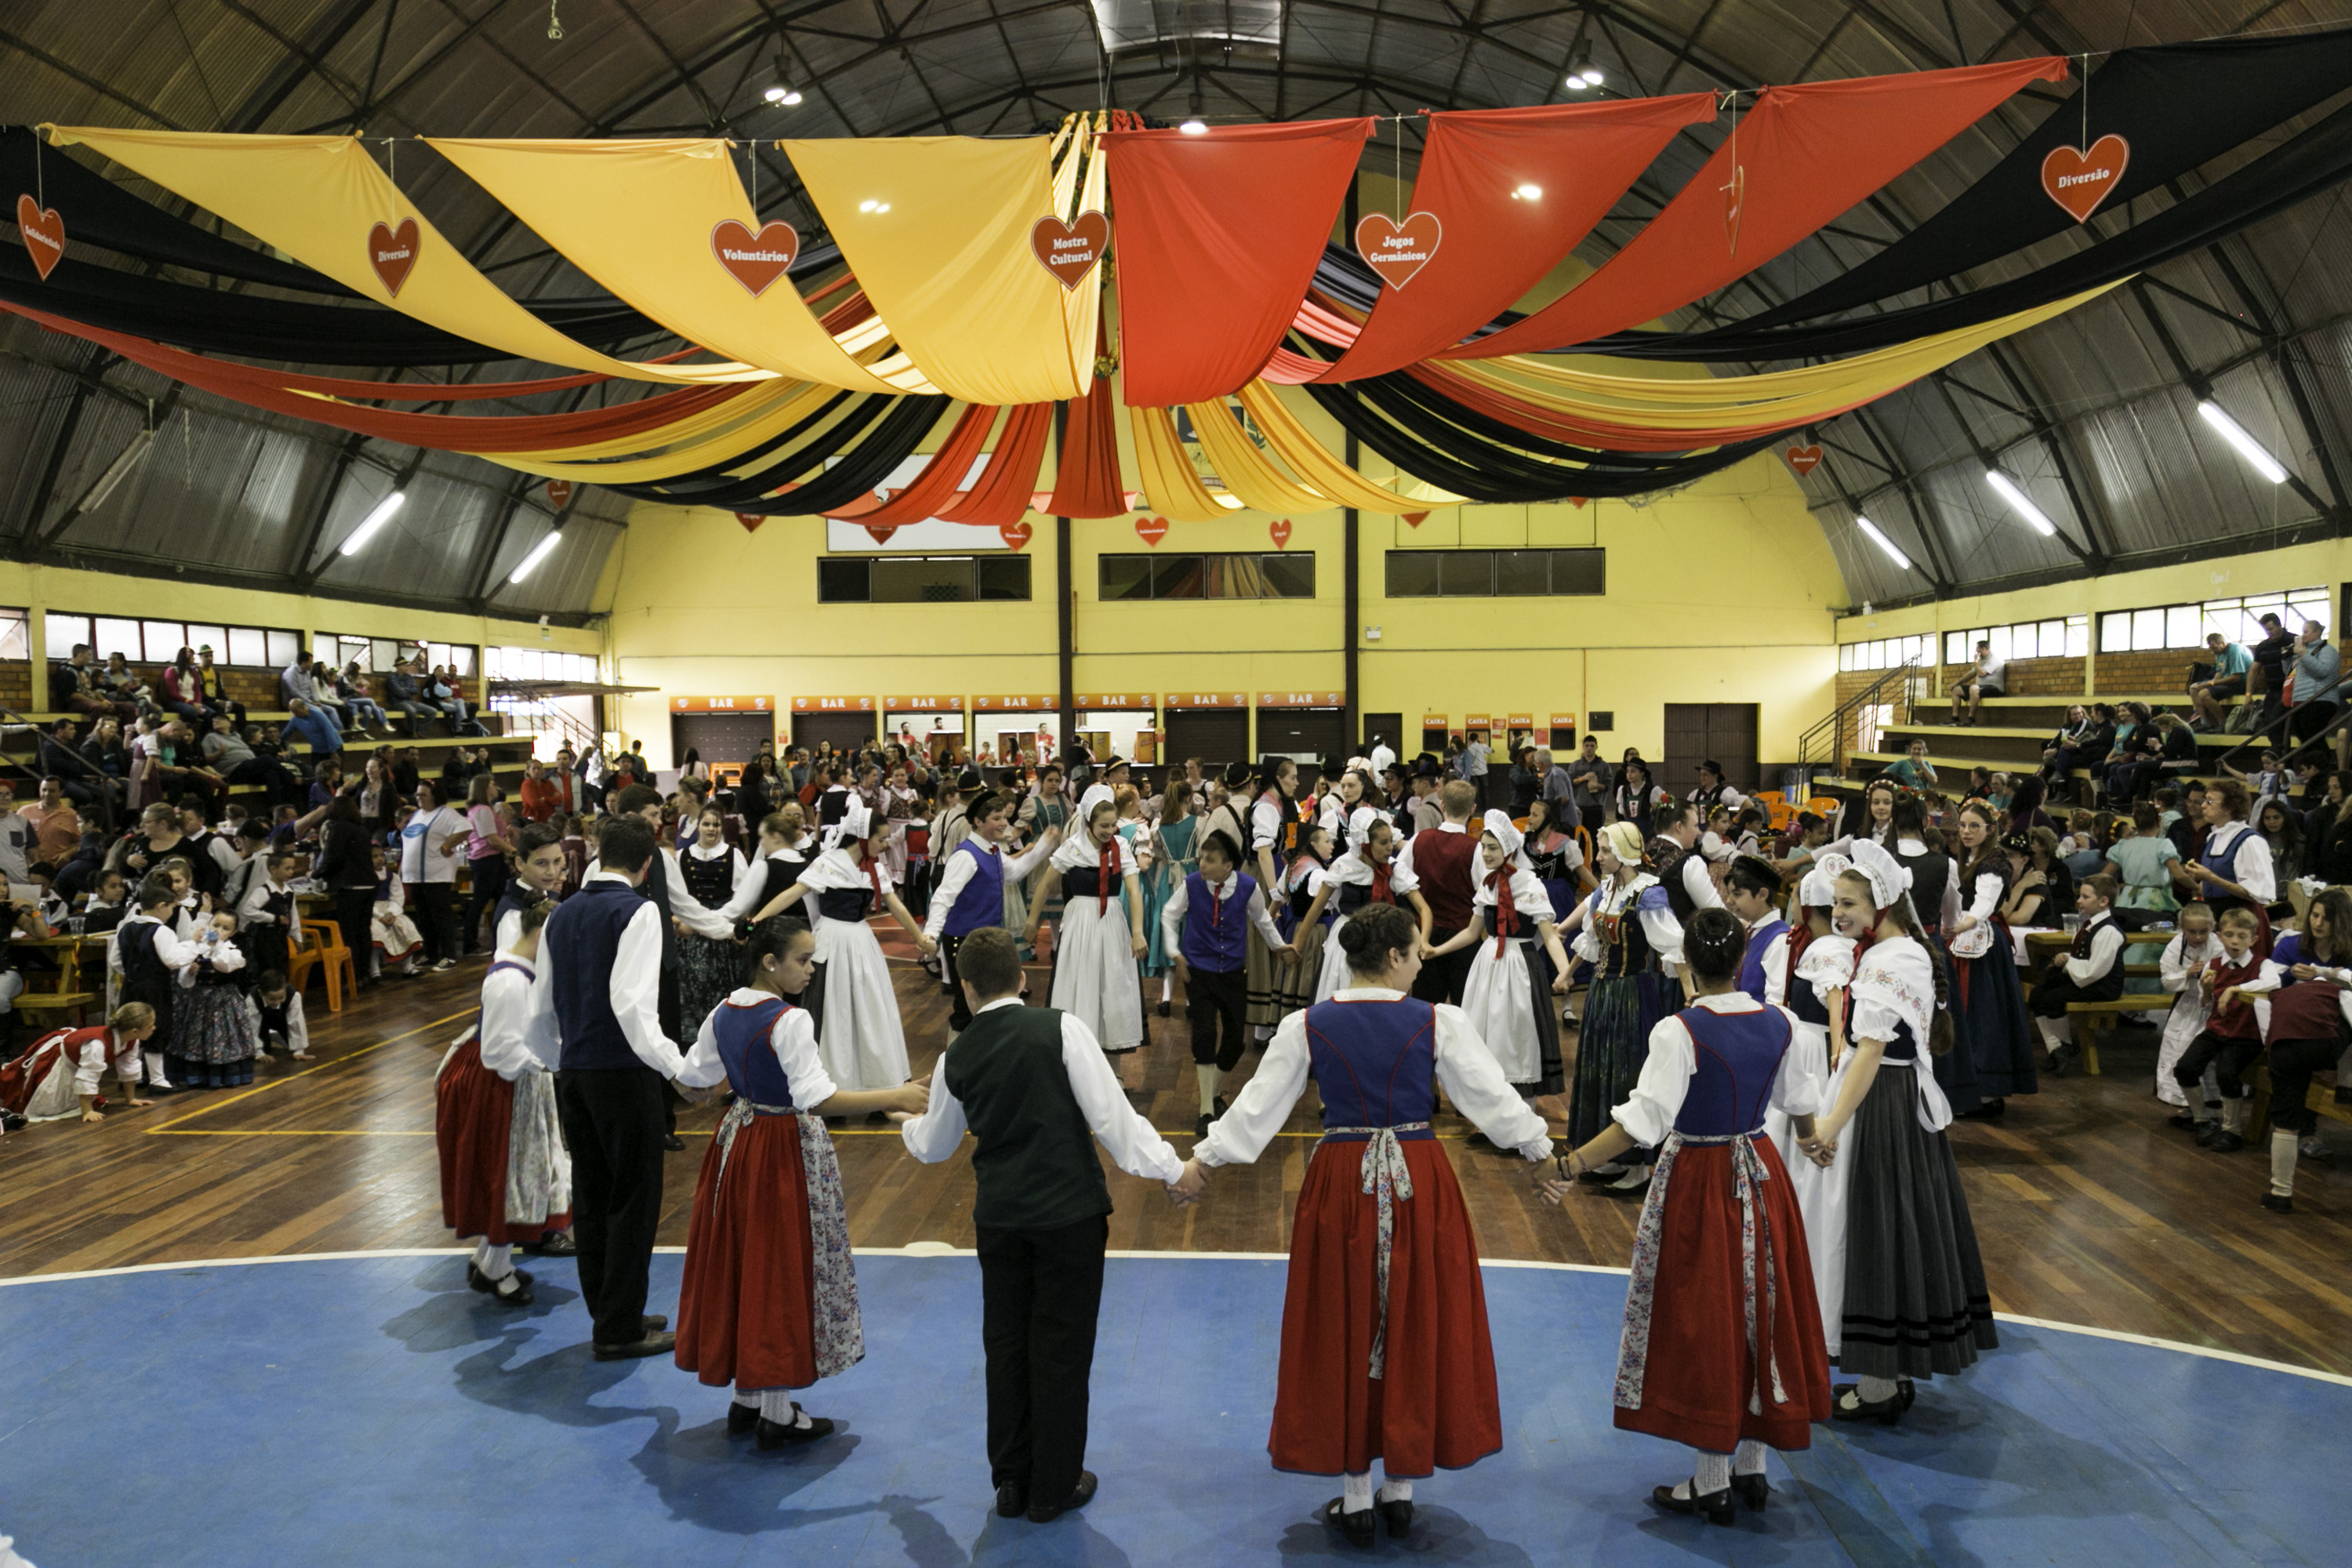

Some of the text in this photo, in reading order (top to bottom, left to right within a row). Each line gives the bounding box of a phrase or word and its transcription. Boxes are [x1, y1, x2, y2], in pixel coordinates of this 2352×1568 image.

[2058, 168, 2110, 188] Diversão
[1053, 237, 1087, 250] Mostra
[1382, 236, 1414, 249] Jogos
[378, 245, 410, 262] Diversão
[723, 249, 789, 262] Voluntários
[1050, 250, 1092, 265] Cultural
[1370, 251, 1426, 263] Germânicos
[709, 698, 734, 708] BAR
[821, 698, 846, 708] BAR
[912, 697, 936, 707] BAR
[1004, 697, 1028, 707] BAR
[1102, 695, 1127, 706] BAR
[1194, 695, 1218, 705] BAR
[1289, 693, 1313, 704] BAR
